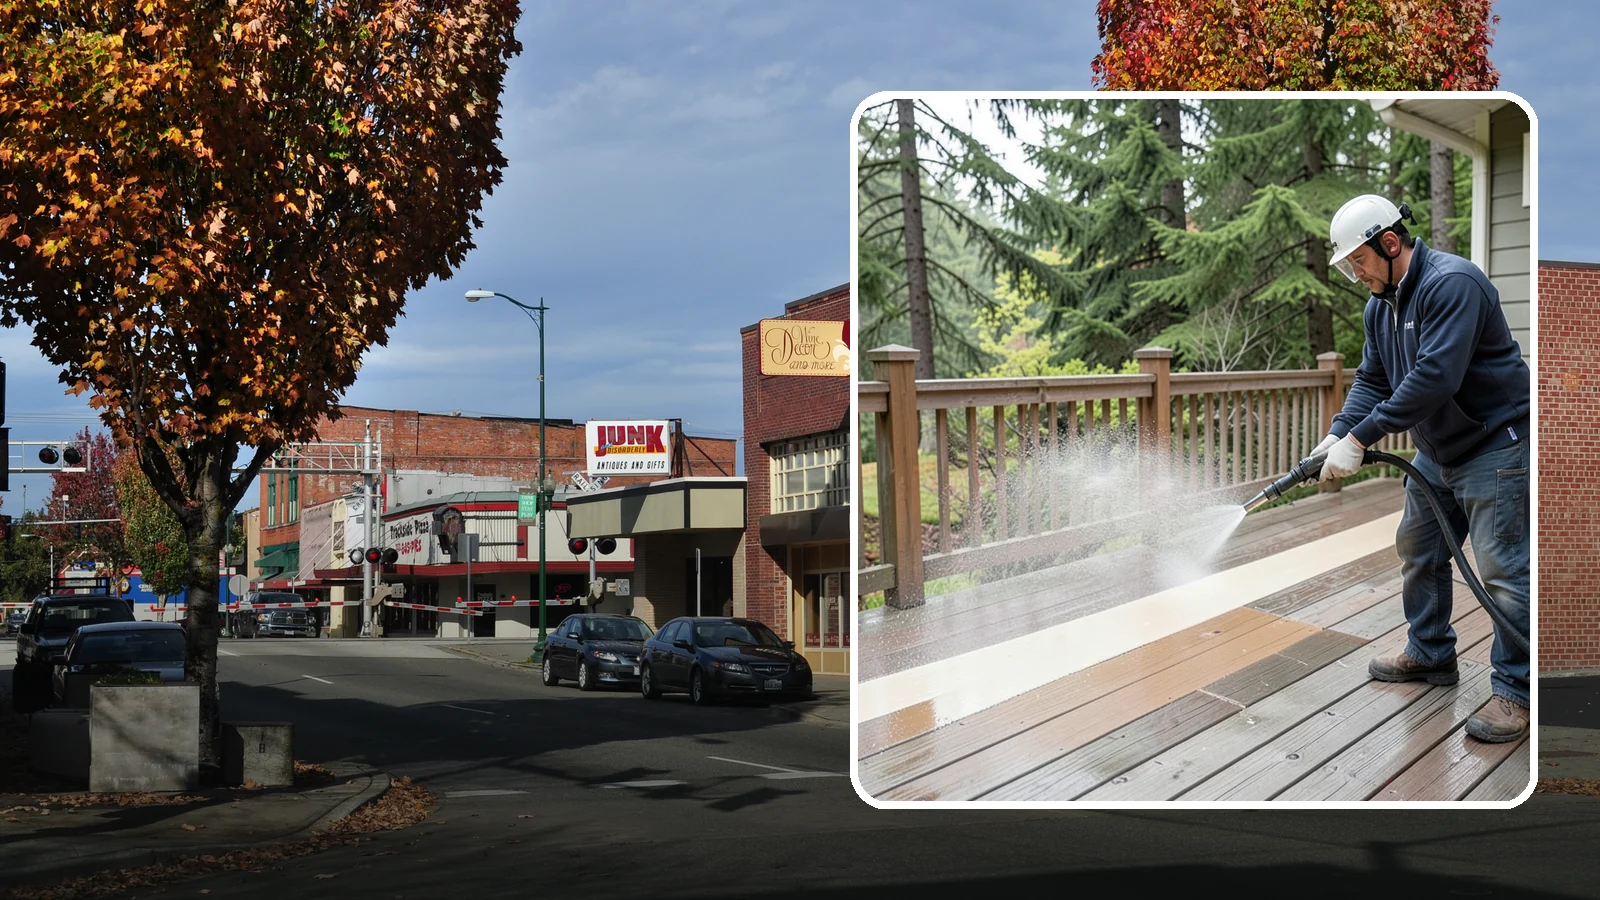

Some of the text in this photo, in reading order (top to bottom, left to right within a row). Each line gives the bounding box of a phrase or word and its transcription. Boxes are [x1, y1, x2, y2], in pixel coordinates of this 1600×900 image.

[595, 425, 665, 457] JUNK
[607, 446, 646, 454] DISORDERLY
[597, 460, 665, 470] ANTIQUES AND GIFTS
[573, 473, 589, 492] RAIL
[352, 498, 365, 511] CRO
[414, 519, 429, 535] Pizza
